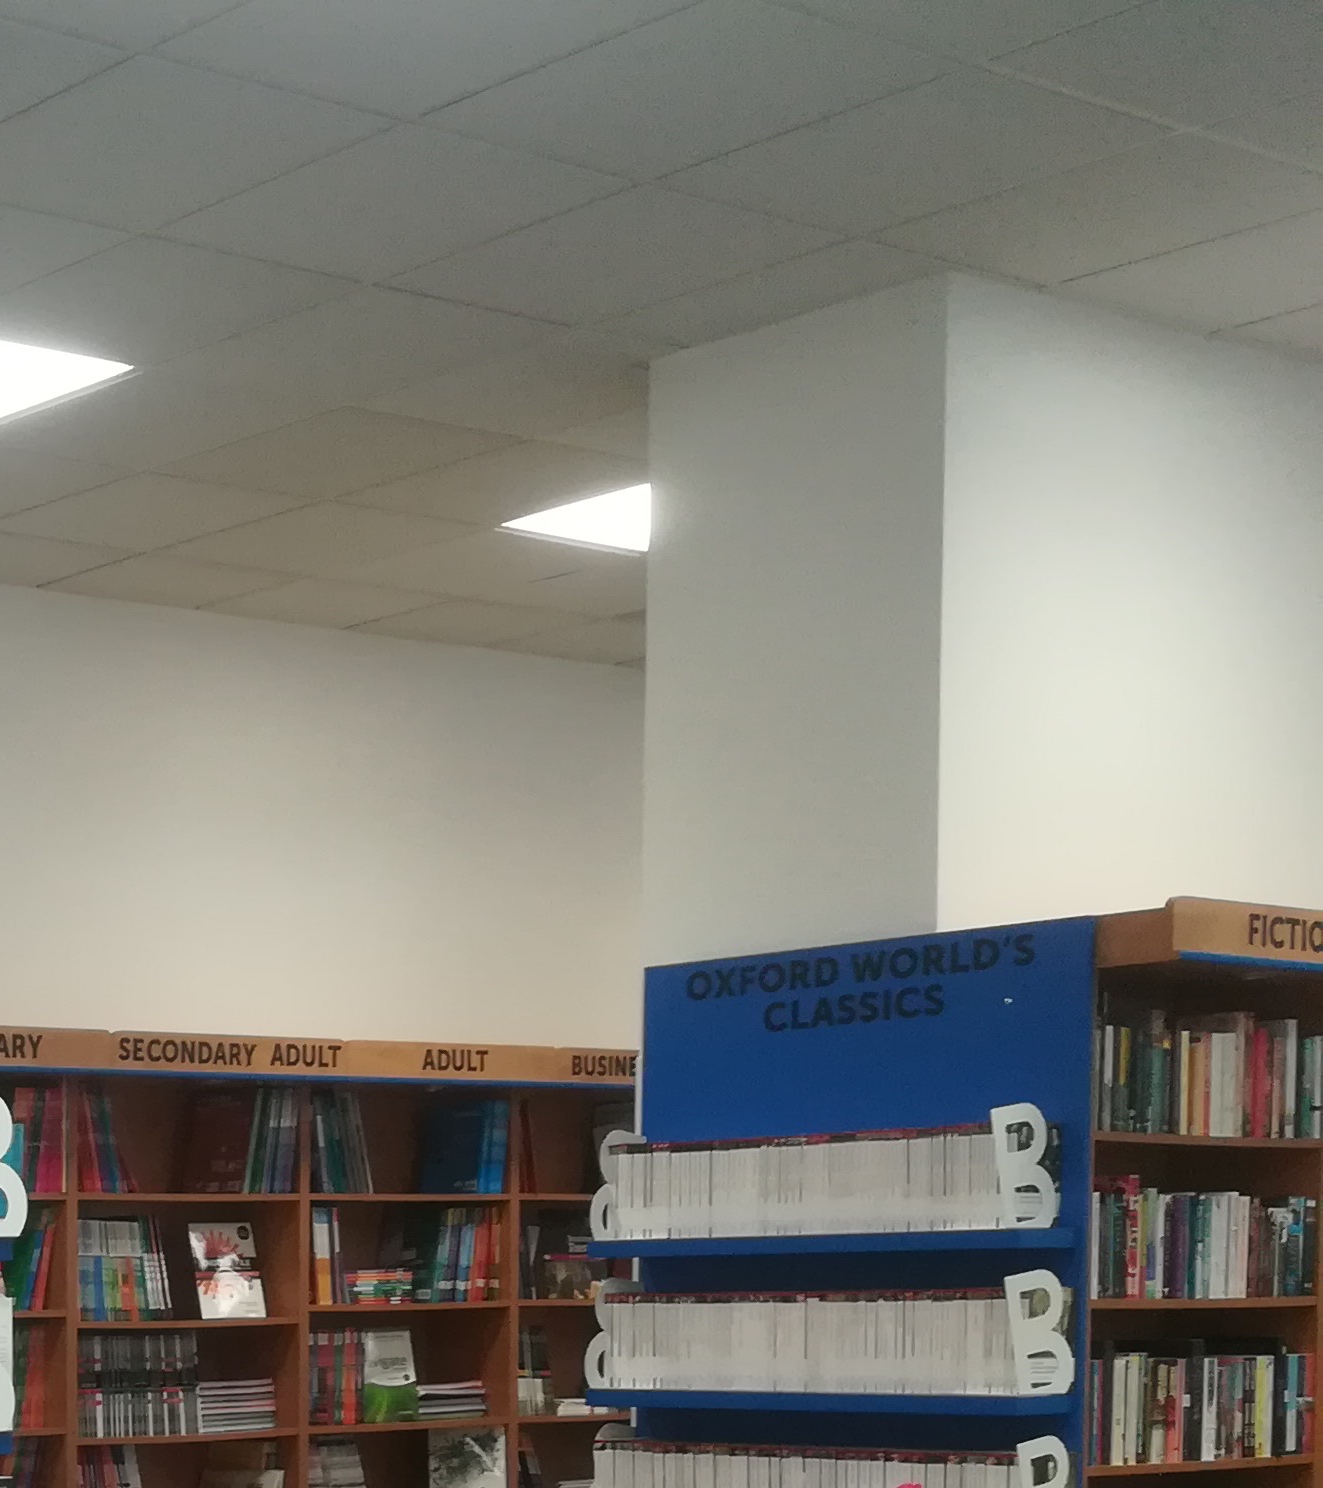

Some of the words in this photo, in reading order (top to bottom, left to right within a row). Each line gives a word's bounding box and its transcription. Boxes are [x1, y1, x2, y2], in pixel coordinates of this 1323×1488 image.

[686, 955, 839, 1001] OXFORD
[853, 932, 1037, 985] WORLD'S
[762, 984, 945, 1034] CLASSICS
[118, 1036, 256, 1068] SECONDARY
[269, 1042, 342, 1070] ADULT
[422, 1048, 489, 1074] ADULT
[571, 1053, 638, 1078] BUSINE
